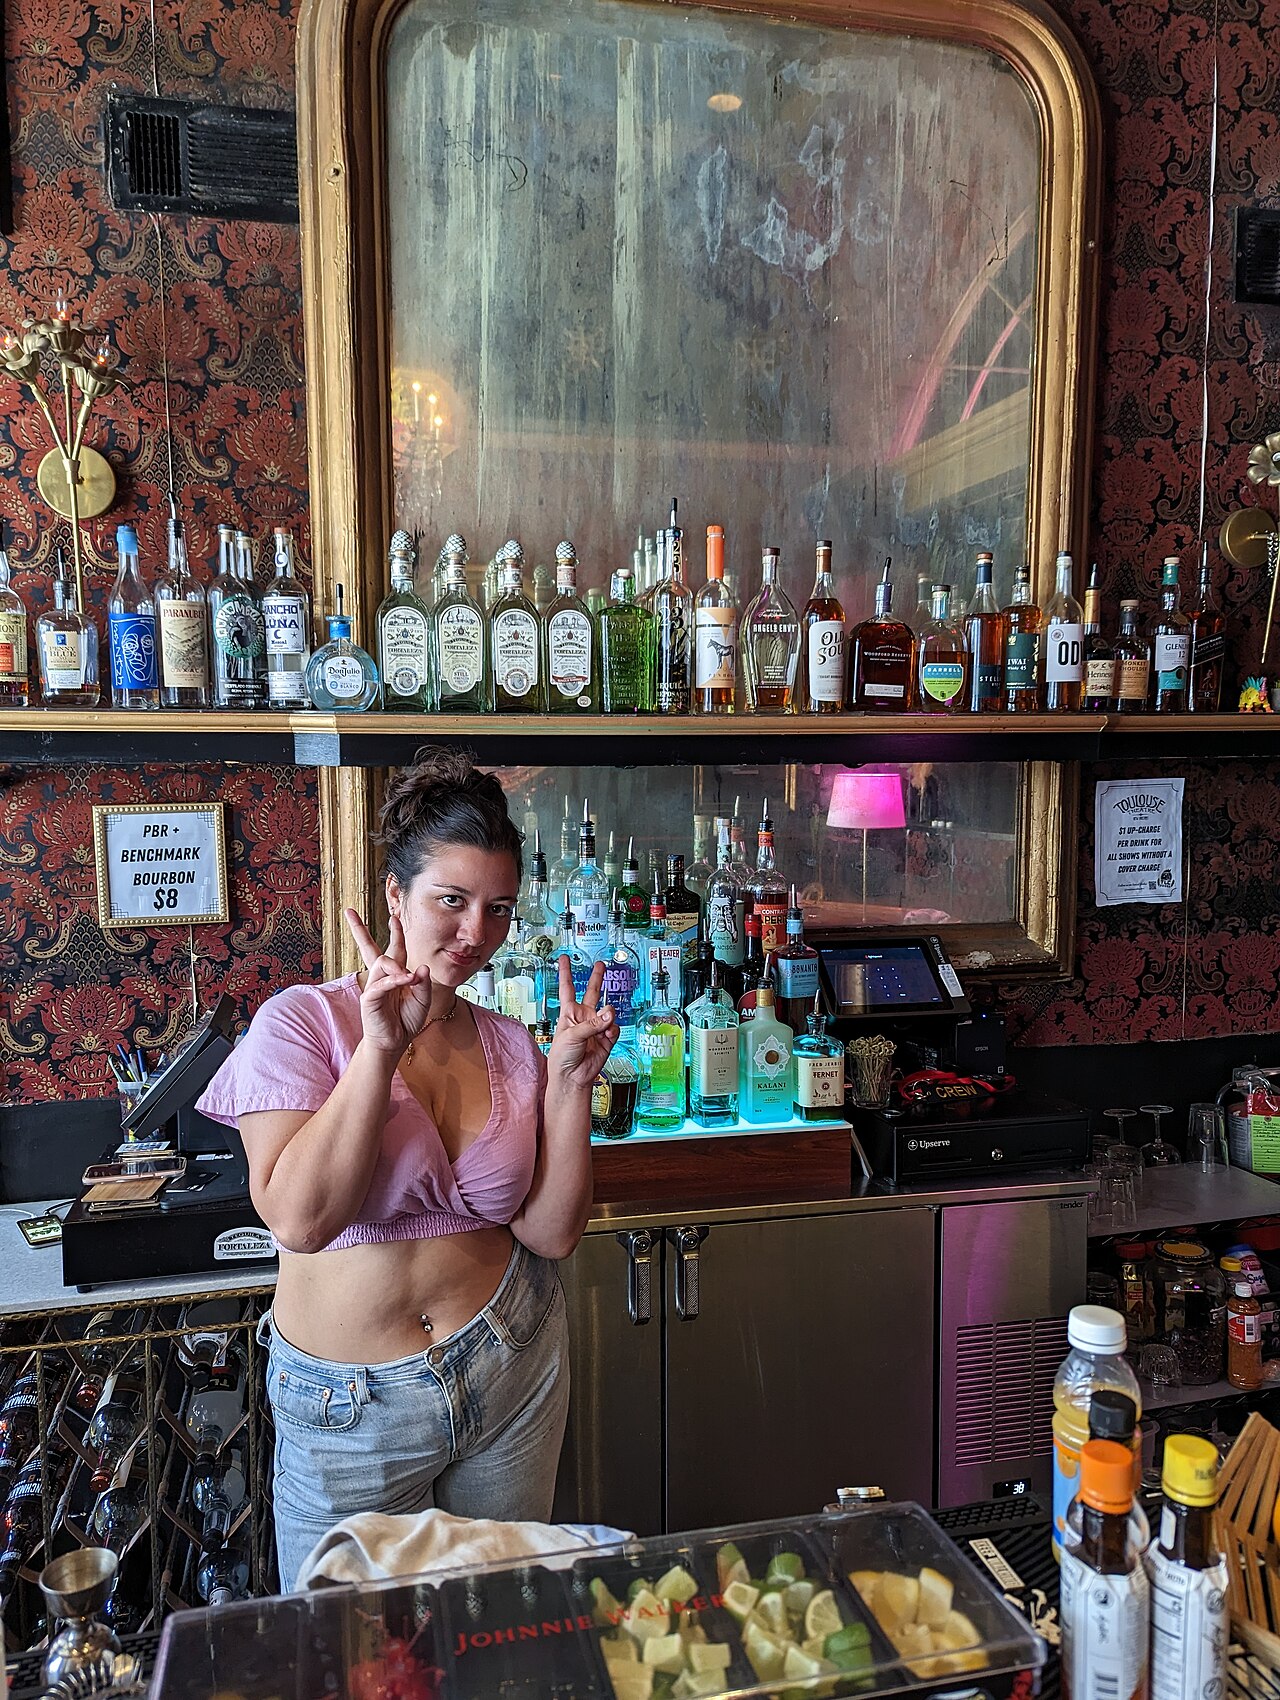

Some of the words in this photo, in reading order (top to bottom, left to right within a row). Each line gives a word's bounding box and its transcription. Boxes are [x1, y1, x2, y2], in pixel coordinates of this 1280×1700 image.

[821, 631, 845, 645] OLD
[1113, 794, 1166, 813] TOULOUSE
[143, 825, 169, 838] PBR
[1119, 827, 1126, 835] $1
[1127, 826, 1161, 834] UP-CHARGE
[1117, 840, 1129, 848] PER
[1130, 839, 1149, 847] DRINK
[121, 847, 201, 863] BENCHMARK
[1119, 852, 1140, 860] SHOWS
[1141, 851, 1167, 859] WITHOUT
[1118, 865, 1136, 873] COVER
[1138, 864, 1161, 872] CHARGE
[133, 871, 195, 886] BOURBON
[154, 887, 179, 911] $8
[650, 950, 679, 959] BEFEATER
[936, 1085, 977, 1098] CREW
[920, 1138, 950, 1148] Upserve
[218, 1242, 272, 1251] FORTALEZA
[454, 1615, 595, 1656] JOHNNIE
[606, 1592, 726, 1624] WALKER
